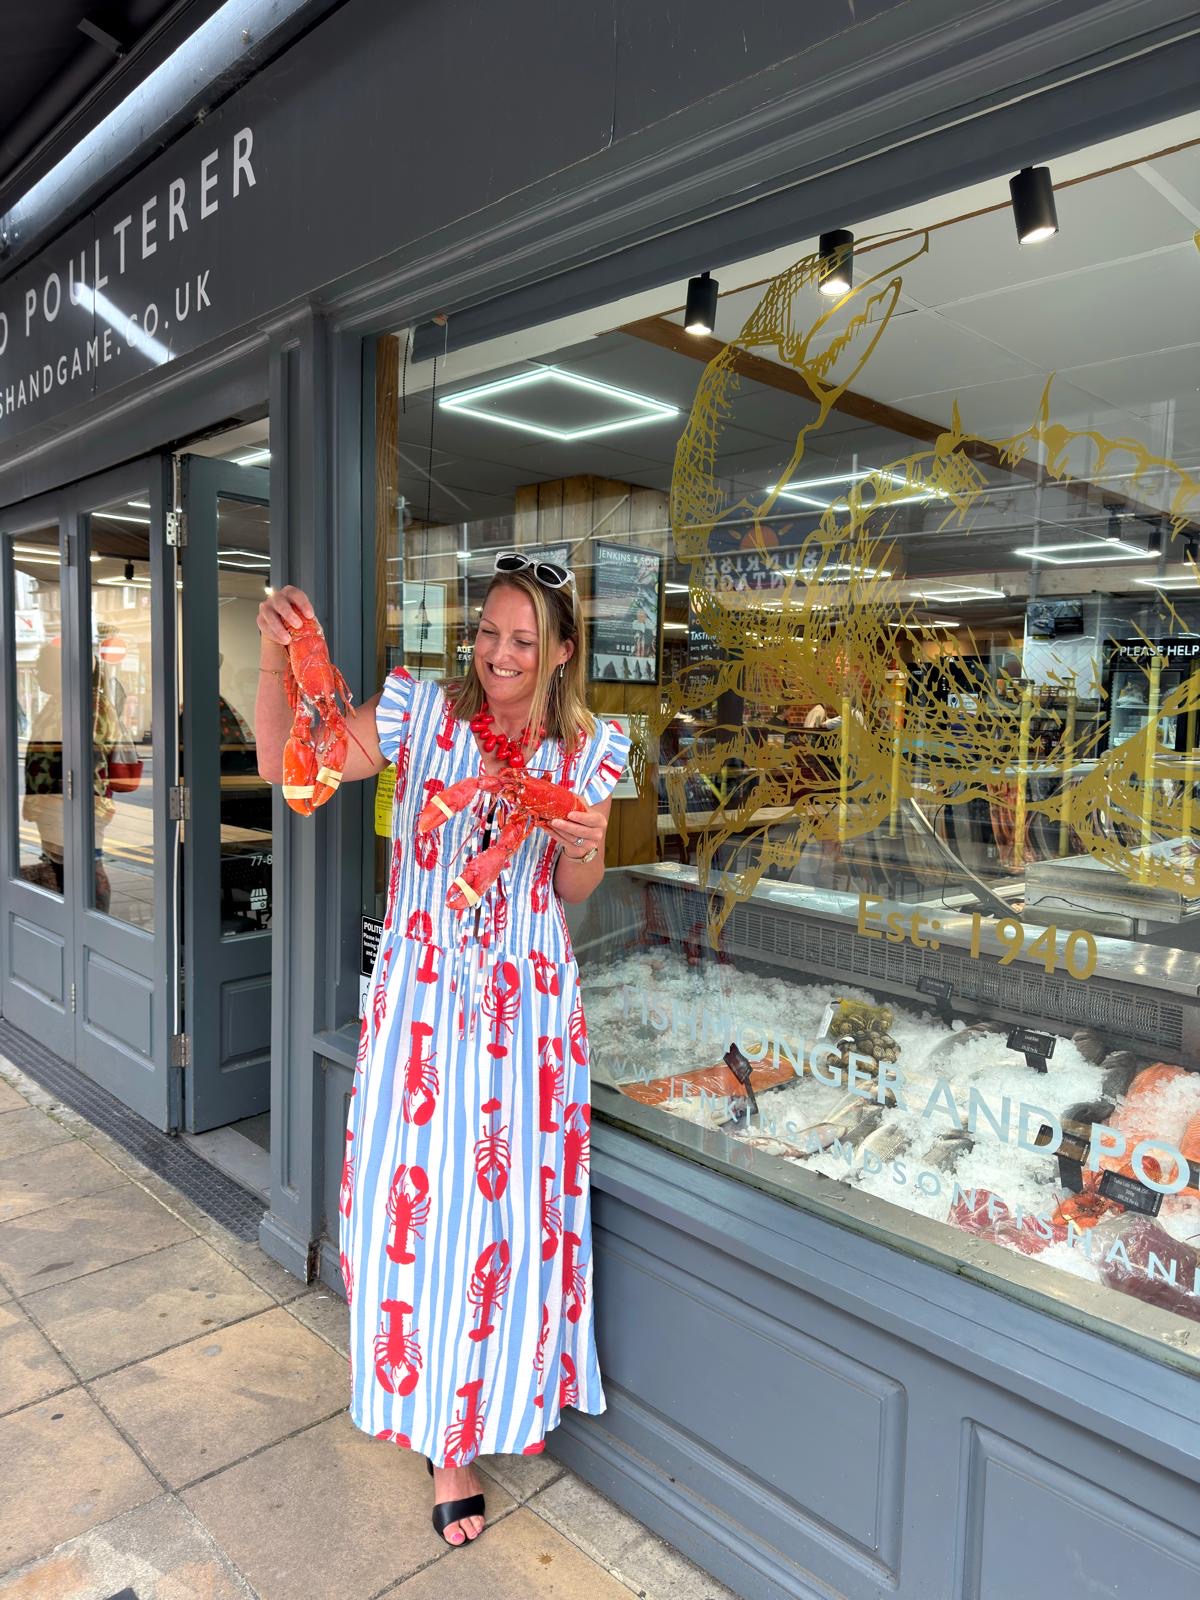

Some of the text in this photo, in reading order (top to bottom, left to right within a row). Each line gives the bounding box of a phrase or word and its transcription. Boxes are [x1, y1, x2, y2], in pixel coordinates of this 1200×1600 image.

[25, 126, 256, 336] POULTERER
[599, 549, 631, 562] JENKINS
[1119, 645, 1200, 657] PLEASE HELP
[363, 921, 382, 934] POLITE
[857, 893, 1097, 980] Est: 1940
[622, 983, 1200, 1194] FISHMONGER AND PO
